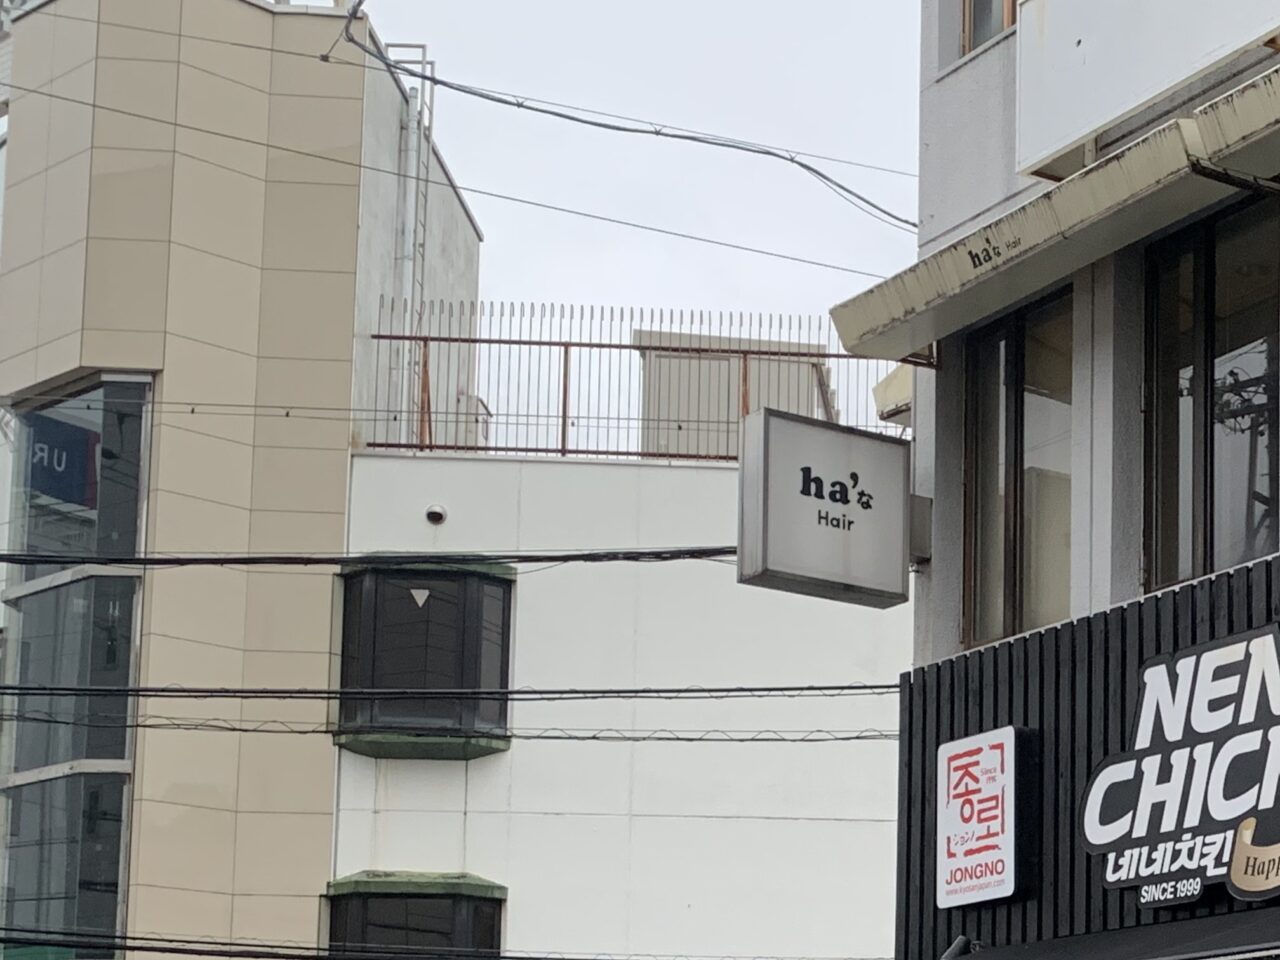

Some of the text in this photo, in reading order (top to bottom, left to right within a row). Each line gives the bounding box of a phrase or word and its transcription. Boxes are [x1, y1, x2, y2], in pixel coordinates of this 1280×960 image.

[818, 509, 854, 531] Hair
[1105, 828, 1235, 883] 네네치킨
[945, 858, 1005, 886] JONGNO
[1140, 877, 1201, 903] SINCE 1999
